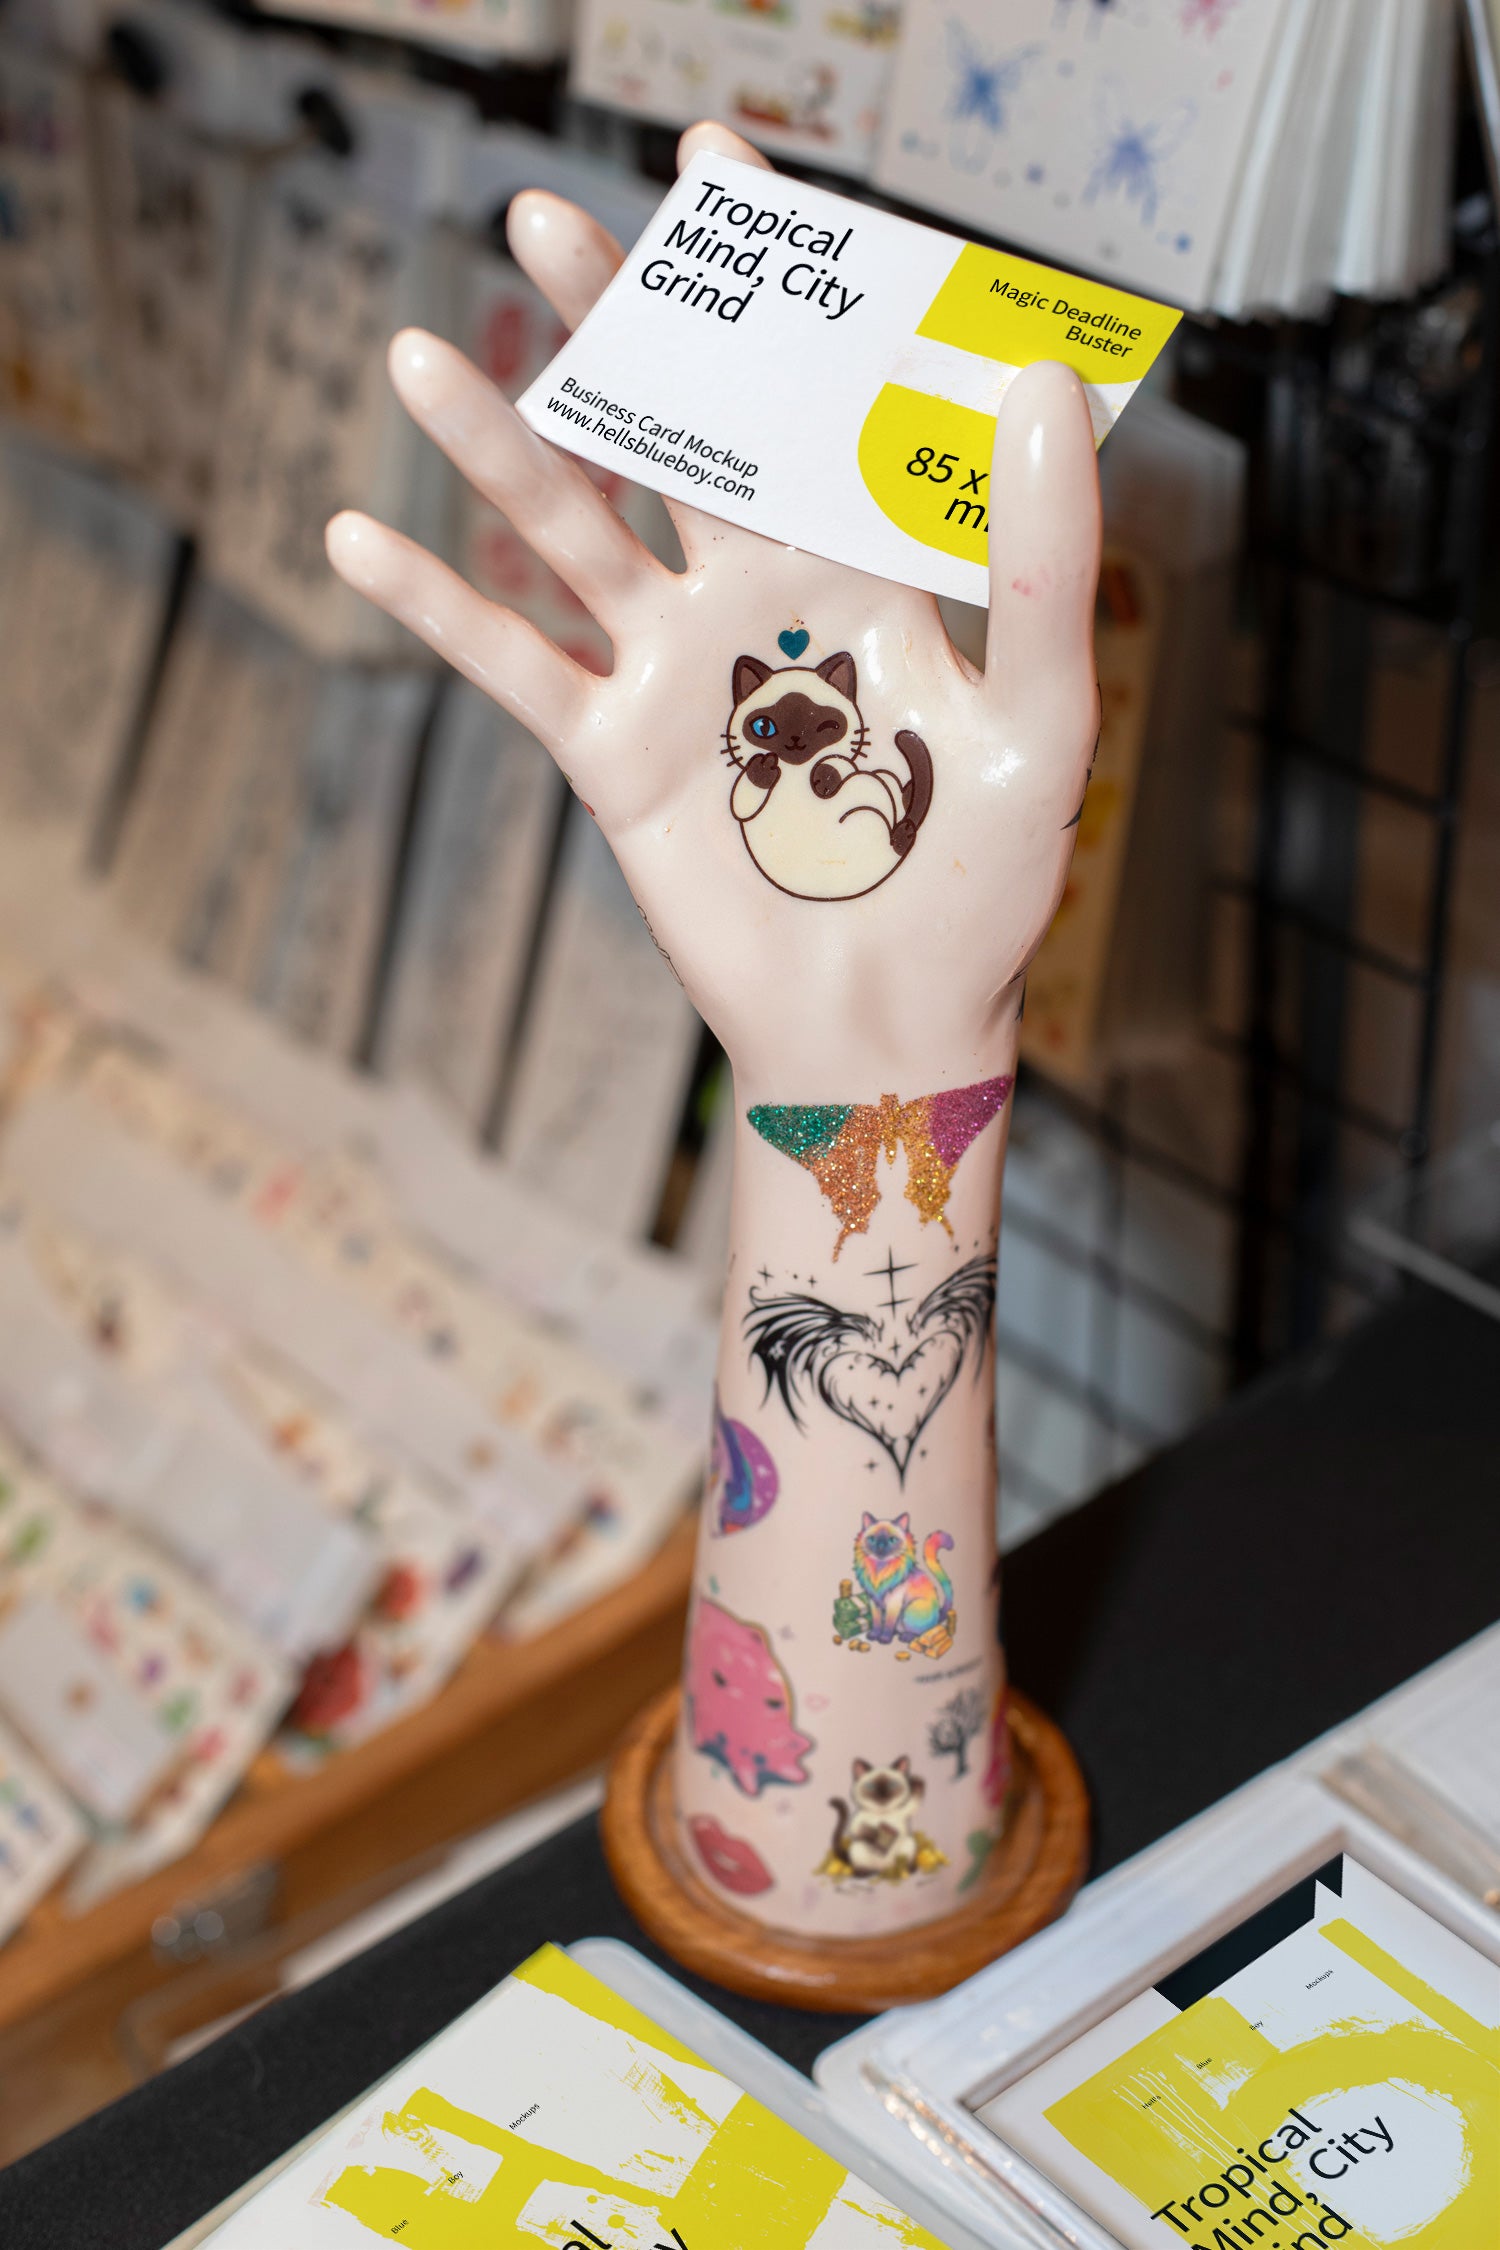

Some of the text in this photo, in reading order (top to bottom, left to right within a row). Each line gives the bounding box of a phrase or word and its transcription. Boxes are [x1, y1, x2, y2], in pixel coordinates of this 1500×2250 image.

[695, 181, 854, 262] Tropical
[641, 259, 755, 324] Grind
[663, 219, 865, 321] Mind, City
[989, 278, 1142, 341] Magic Deadline
[1065, 325, 1133, 359] Buster
[547, 397, 755, 501] www.hellsblueboy.com
[560, 377, 759, 479] Business Card Mockup
[906, 447, 989, 495] 85 x
[944, 498, 989, 533] m
[1305, 1969, 1334, 1990] Mockups
[390, 2103, 541, 2235] Blue Boy Mockups
[1150, 2108, 1323, 2233] Tropical
[1309, 2116, 1394, 2179] City
